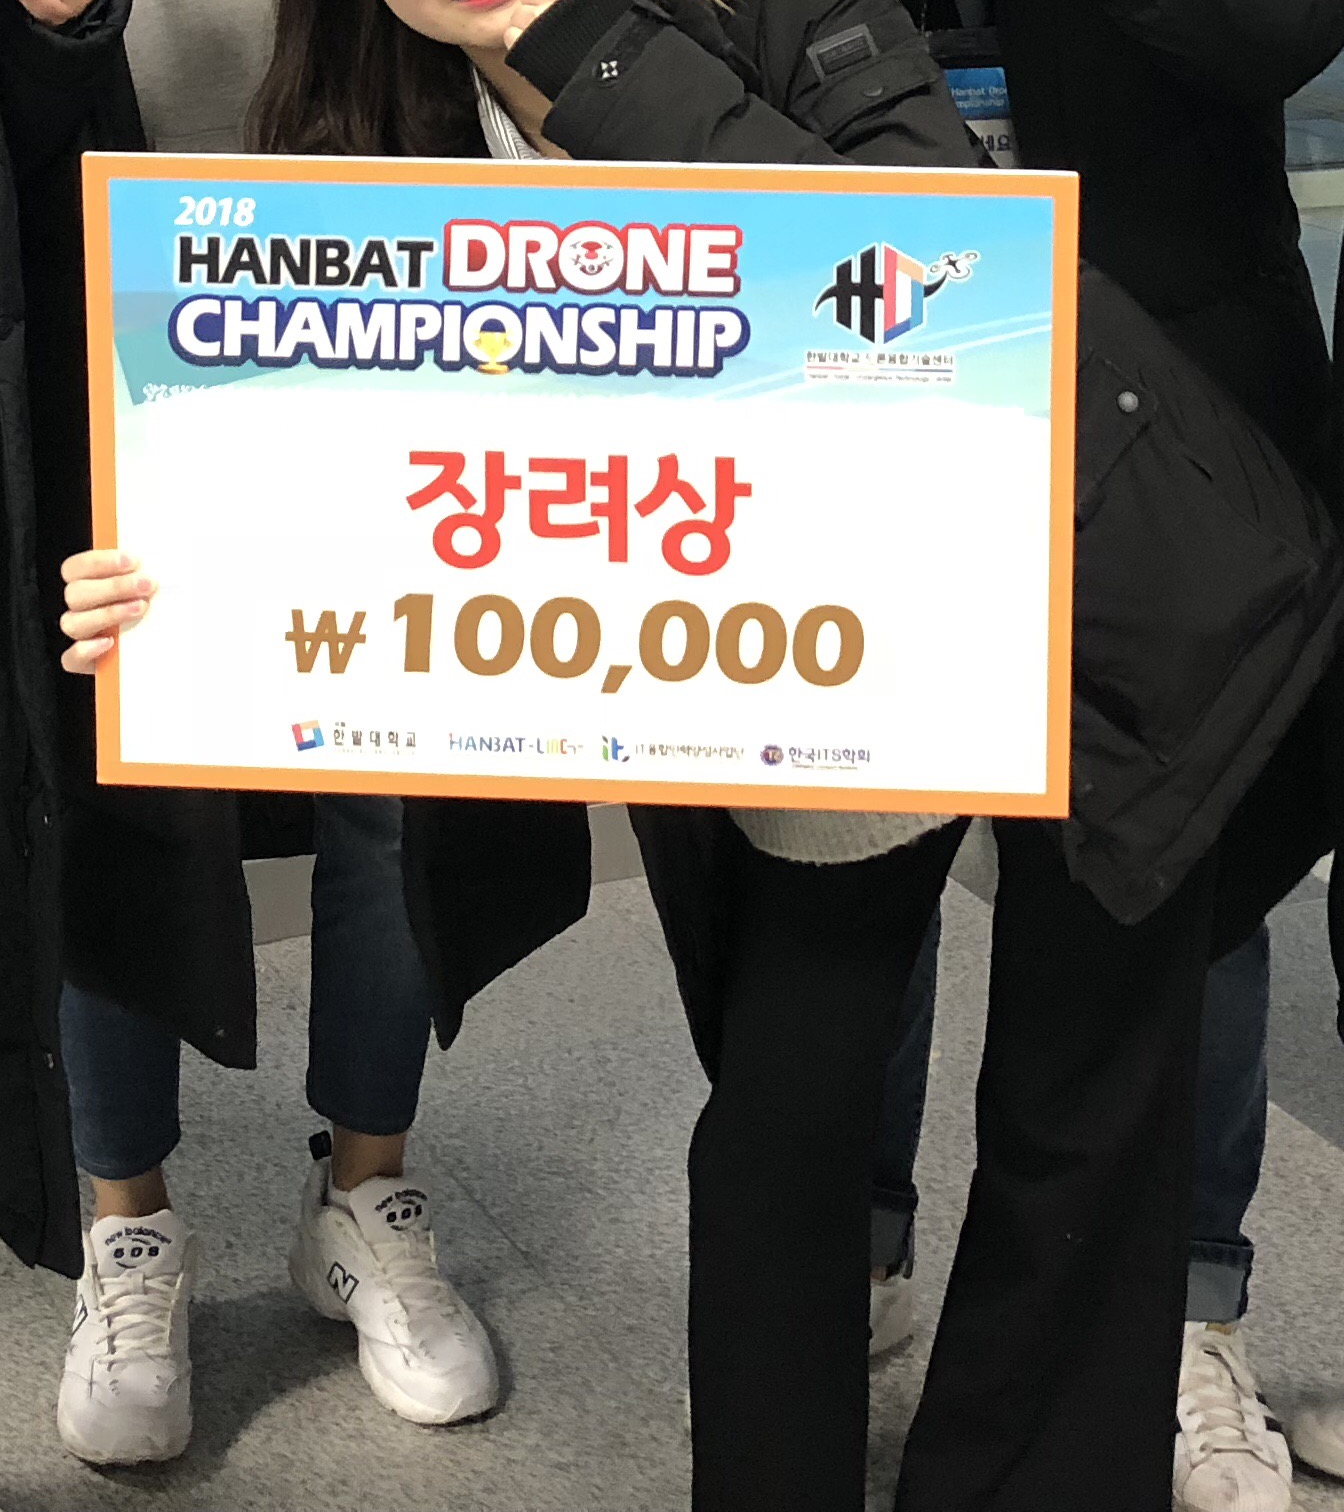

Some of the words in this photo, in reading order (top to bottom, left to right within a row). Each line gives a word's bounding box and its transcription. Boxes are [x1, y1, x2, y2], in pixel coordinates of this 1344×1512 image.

[174, 195, 256, 226] 2018
[178, 235, 435, 289] HANBAT
[447, 223, 739, 293] DRONE
[175, 297, 743, 369] CHAMPIONSHIP
[405, 450, 753, 576] 장려상
